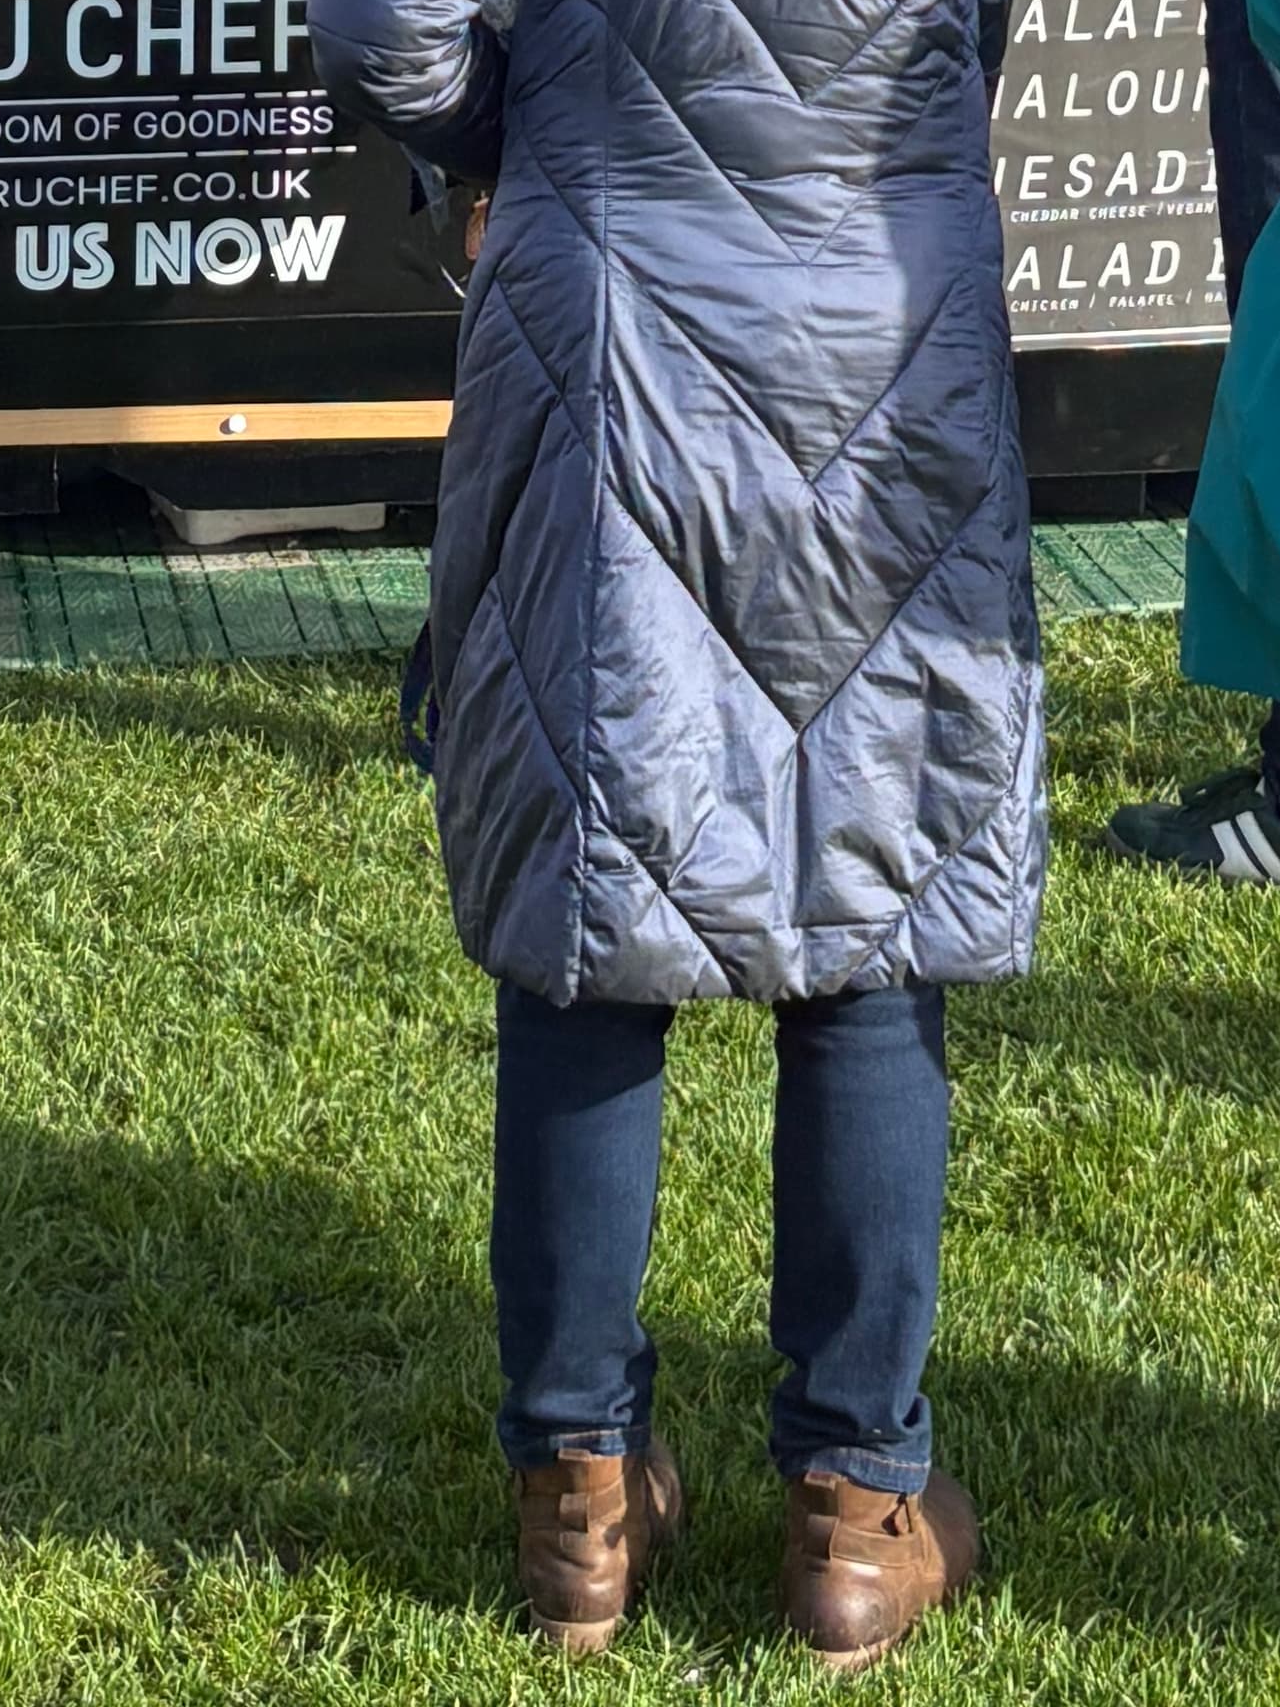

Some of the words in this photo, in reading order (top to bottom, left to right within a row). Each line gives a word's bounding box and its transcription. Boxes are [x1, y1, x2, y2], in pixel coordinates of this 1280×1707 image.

[991, 67, 1210, 120] ALOU
[74, 111, 121, 143] OF
[132, 104, 335, 141] GOODNESS
[1010, 207, 1080, 223] CHEDDAR
[1088, 204, 1148, 220] CHEESE
[14, 220, 115, 290] US
[134, 214, 346, 287] NOW
[1007, 240, 1181, 292] ALAD
[1010, 298, 1079, 313] CHICKEN
[1108, 292, 1175, 308] FALAFEL
